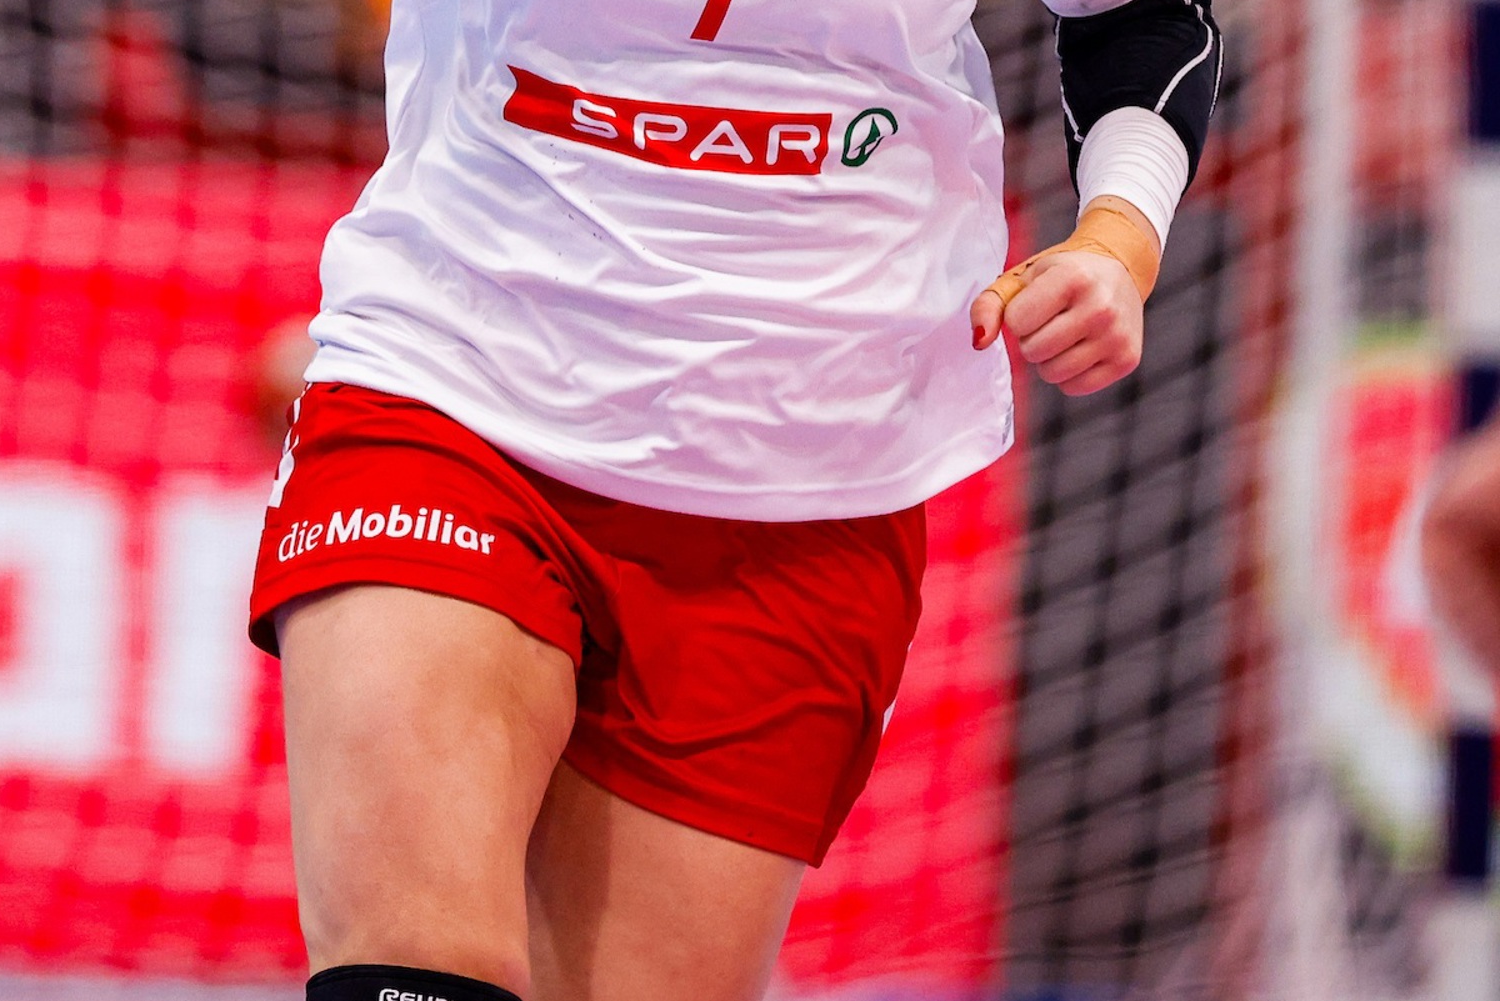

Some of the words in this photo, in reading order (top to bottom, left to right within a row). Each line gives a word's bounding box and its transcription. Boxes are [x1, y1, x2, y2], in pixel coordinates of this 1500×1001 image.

[570, 98, 822, 166] SPAR
[278, 520, 324, 562] die
[325, 504, 495, 555] Mobiliar
